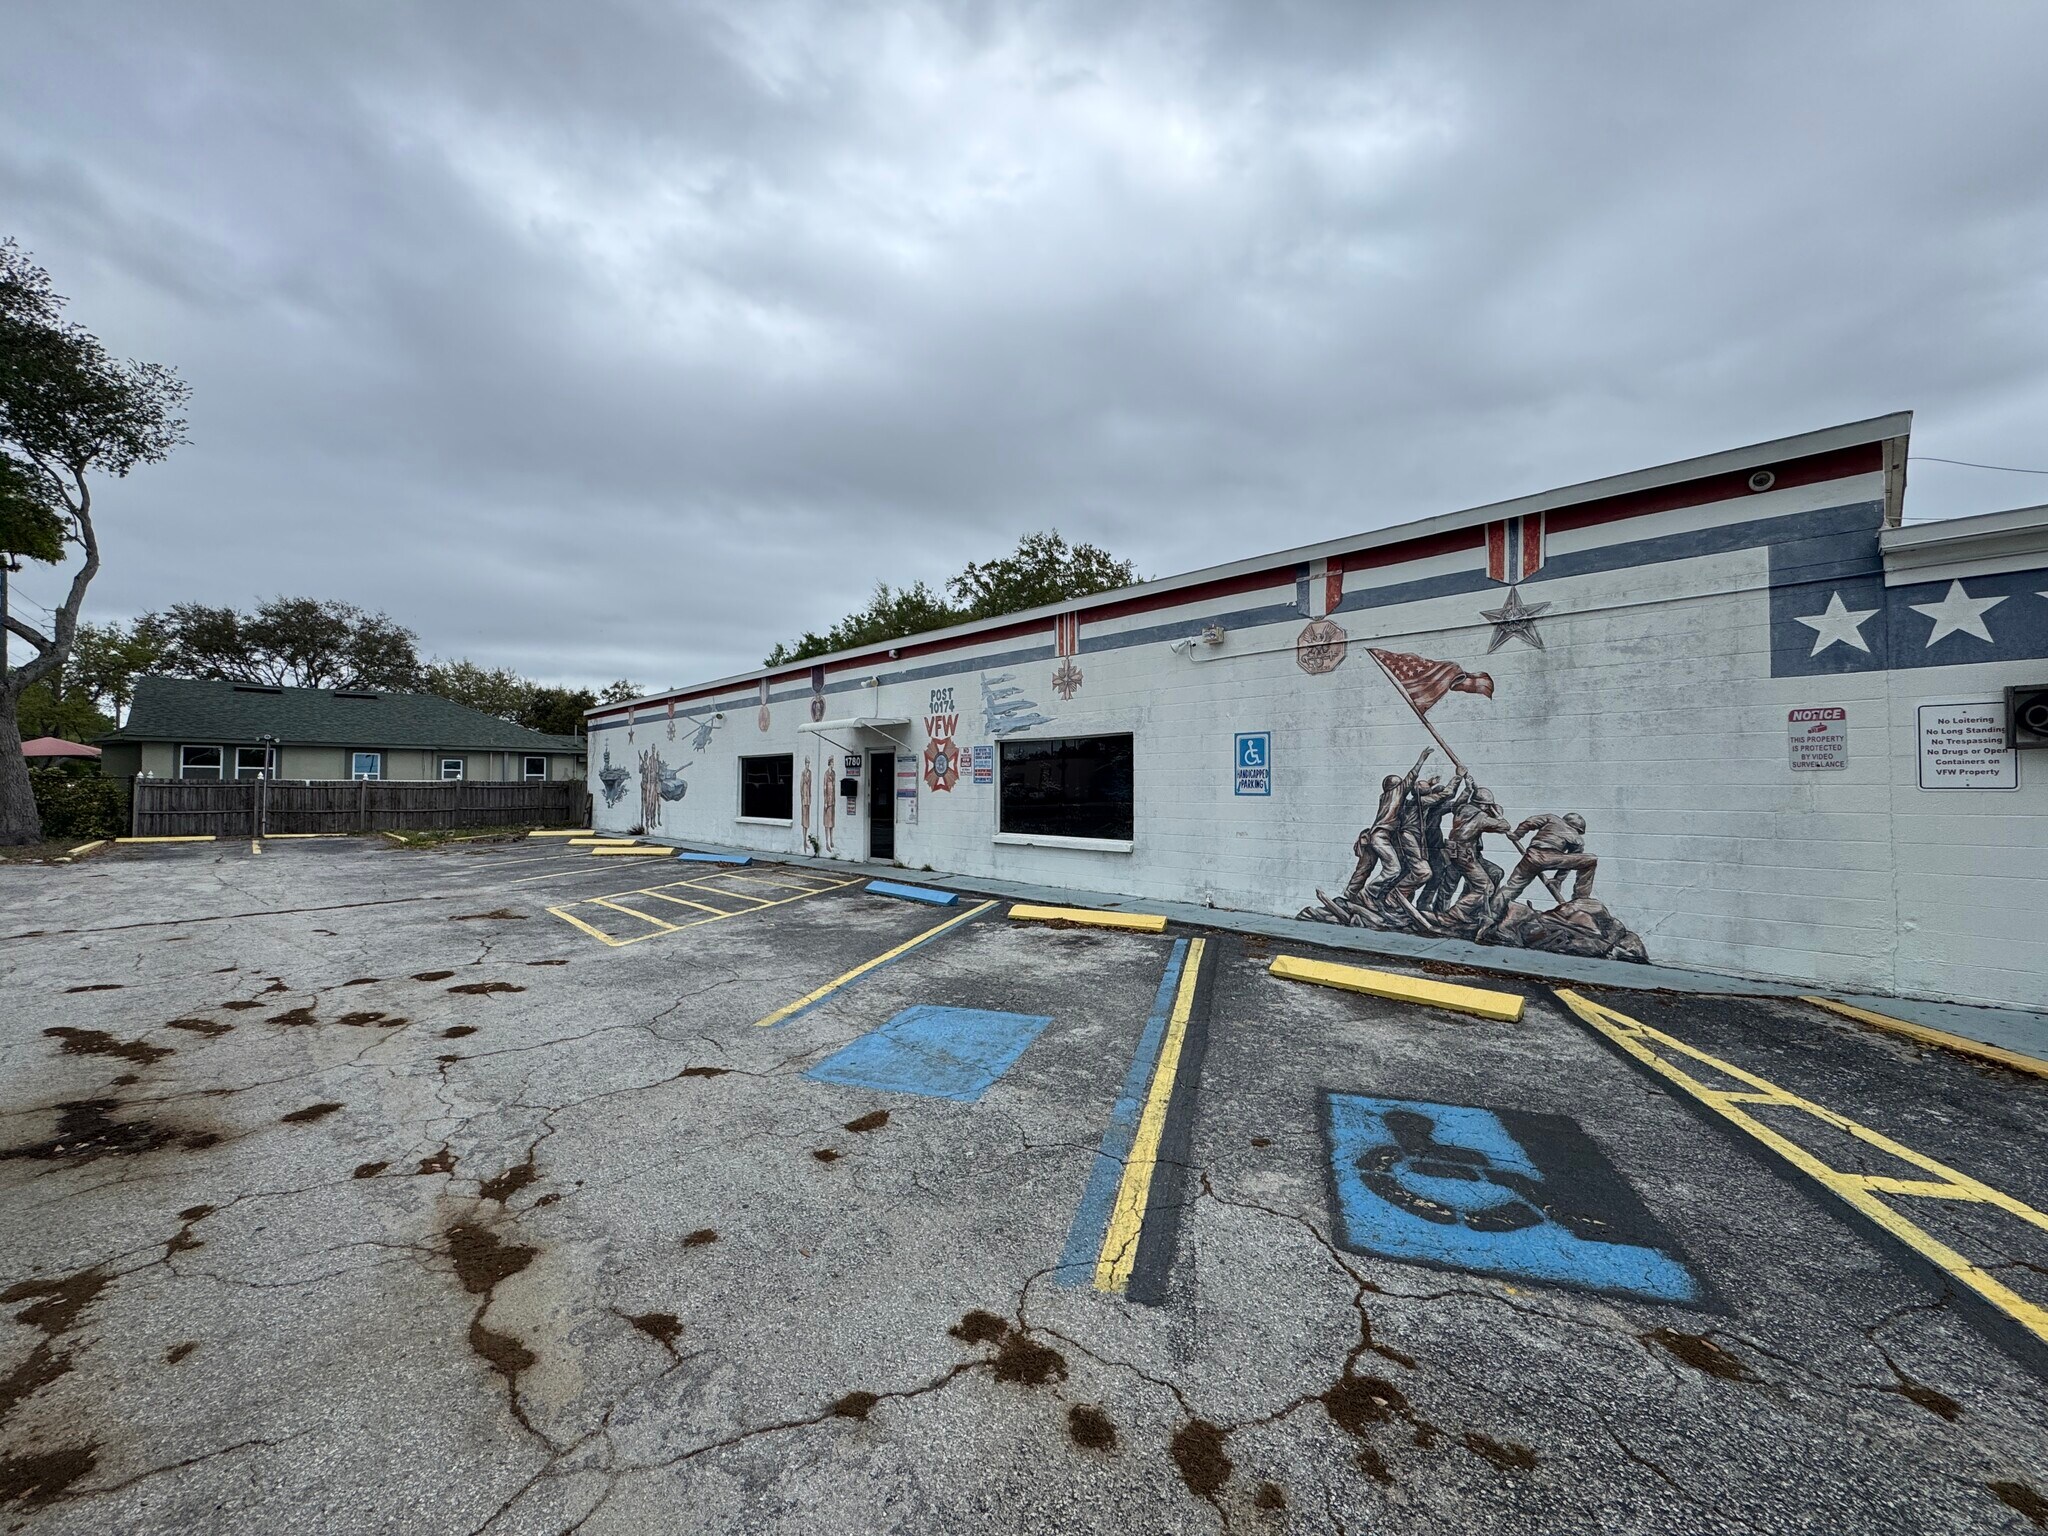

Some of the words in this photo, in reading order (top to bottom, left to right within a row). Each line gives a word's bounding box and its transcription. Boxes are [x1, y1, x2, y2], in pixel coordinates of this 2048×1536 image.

[930, 688, 954, 702] POST
[929, 700, 955, 714] 10174
[1792, 709, 1842, 720] NOTICE
[924, 714, 959, 737] VFW
[1946, 737, 2003, 745] Trespassing
[846, 756, 861, 766] 1780
[1241, 779, 1264, 789] PARKING
